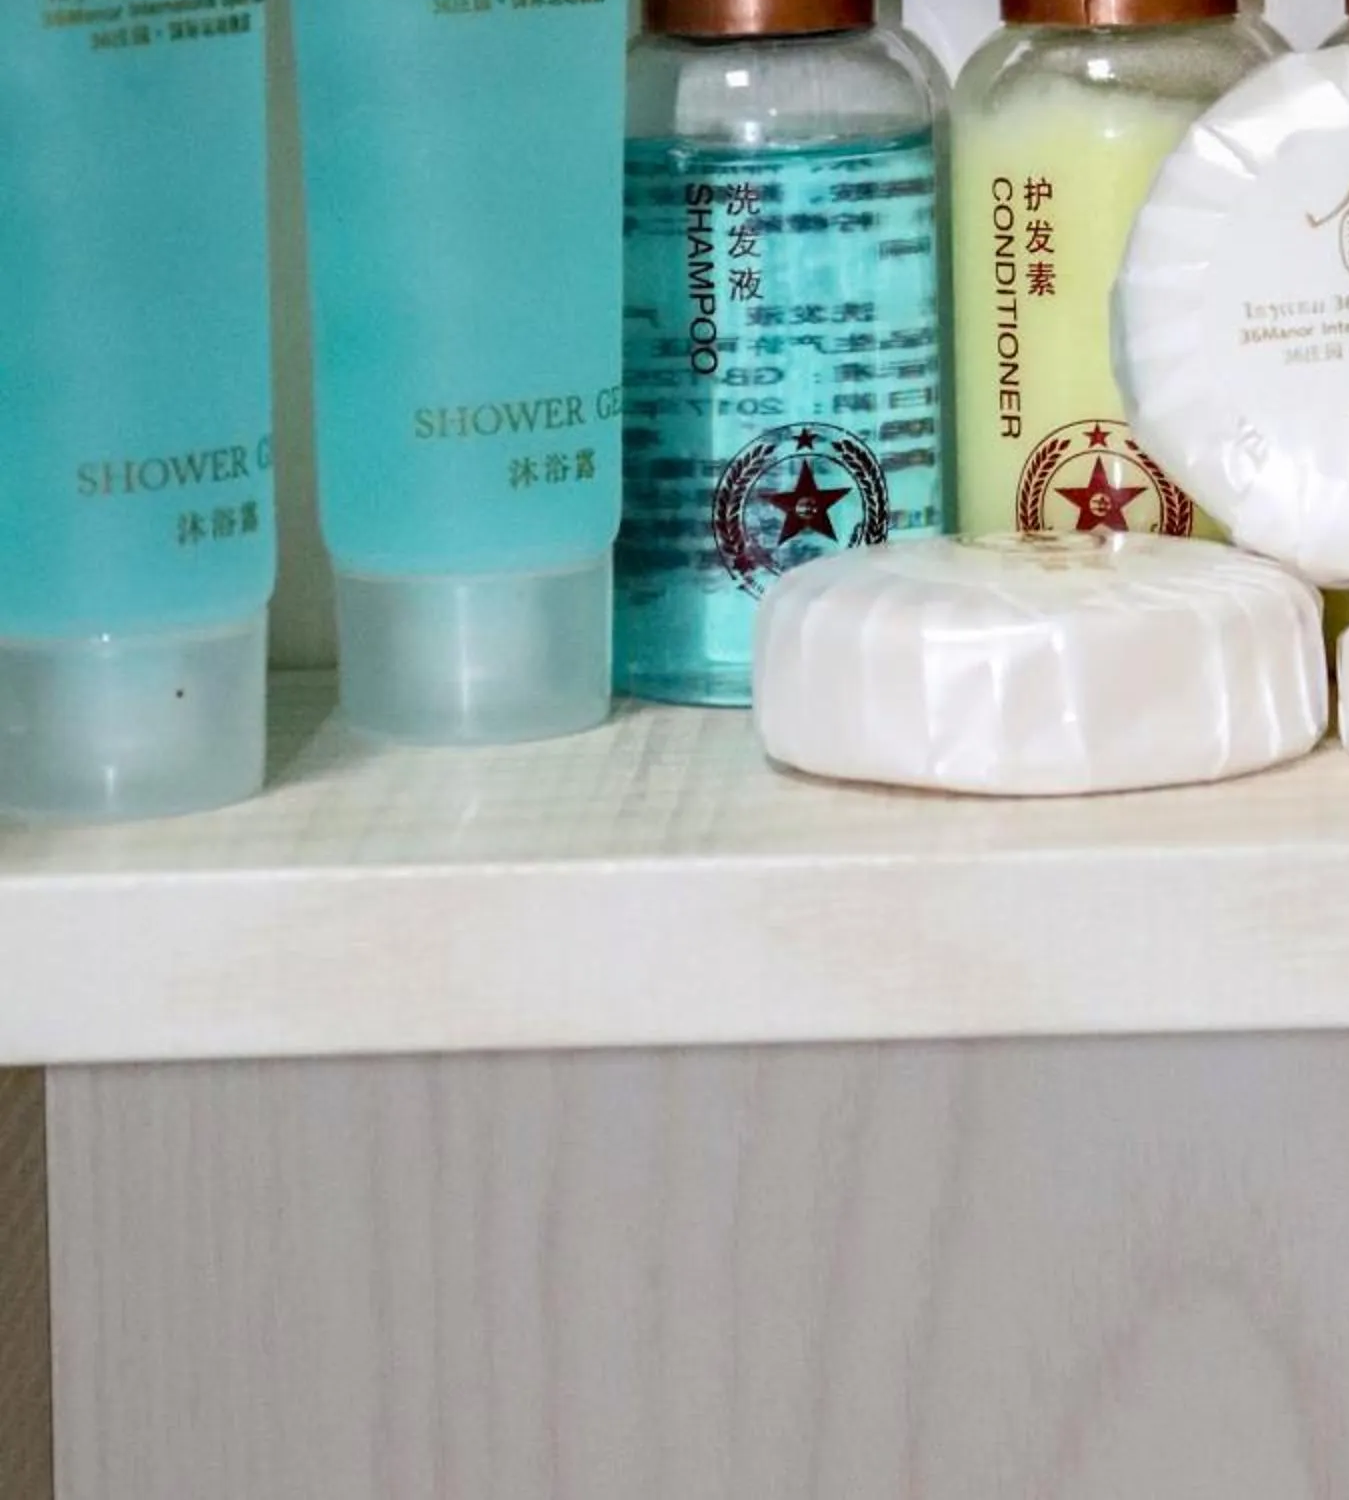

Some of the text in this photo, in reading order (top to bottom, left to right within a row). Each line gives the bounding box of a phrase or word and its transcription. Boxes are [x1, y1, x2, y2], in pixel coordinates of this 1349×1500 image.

[685, 182, 718, 376] SHAMPOO
[726, 182, 765, 303] 洗发液
[1023, 176, 1057, 297] 护发素
[991, 177, 1022, 440] CONDITIONER
[76, 448, 249, 497] SHOWER
[414, 394, 586, 440] SHOWER
[508, 447, 598, 490] 沐浴露
